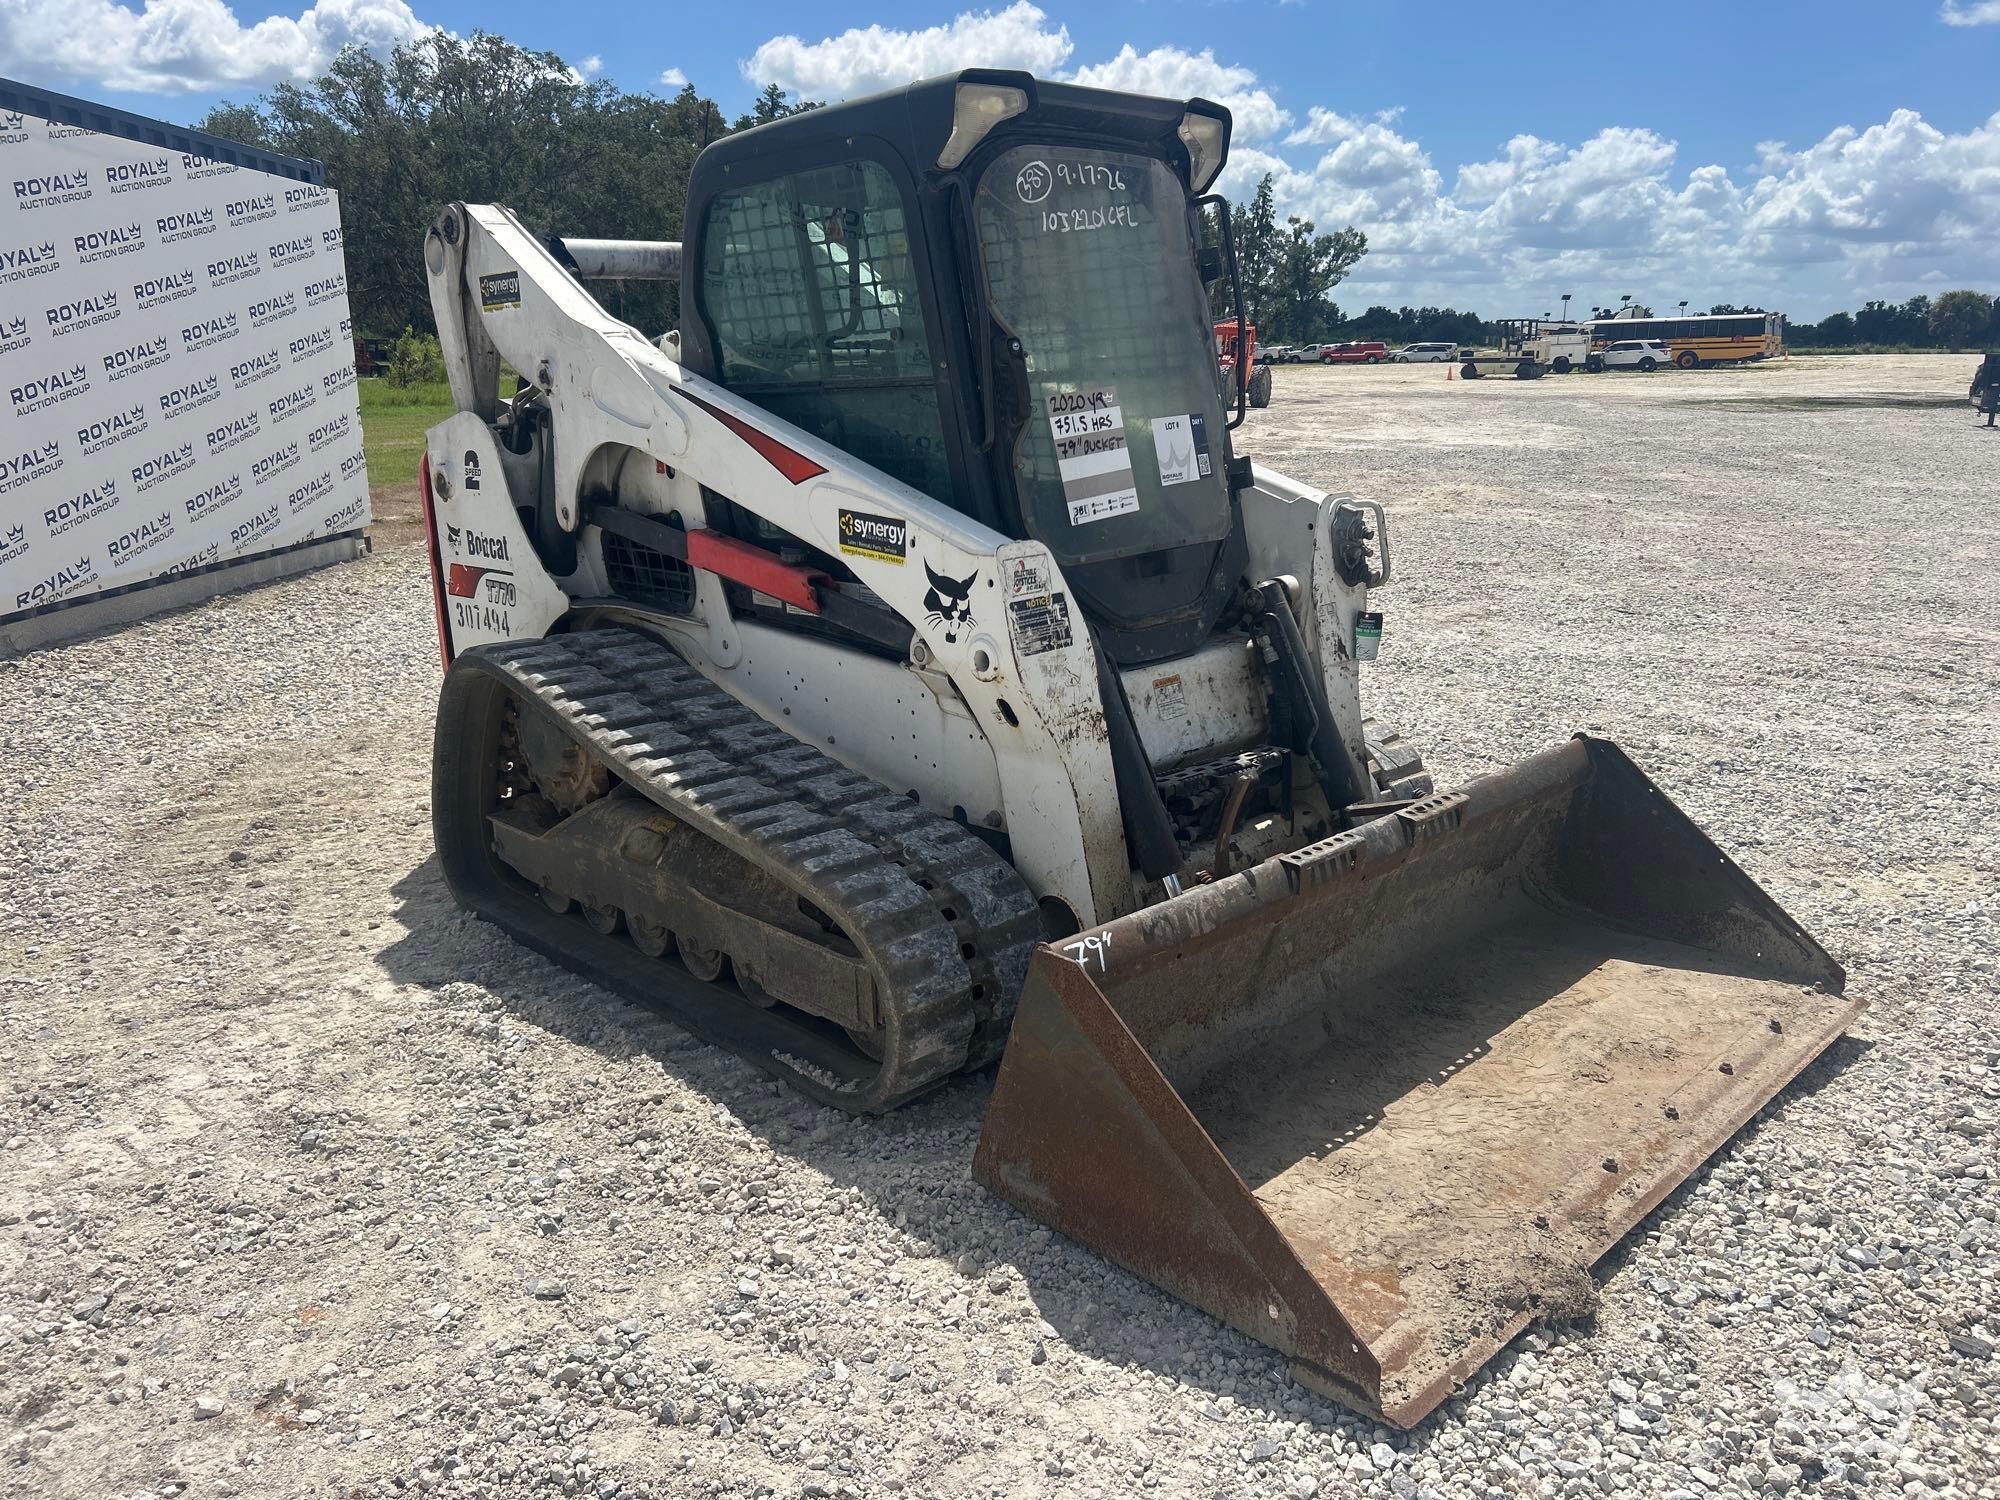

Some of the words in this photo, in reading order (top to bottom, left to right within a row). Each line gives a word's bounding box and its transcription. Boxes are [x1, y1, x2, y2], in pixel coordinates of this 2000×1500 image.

[0, 133, 28, 144] ROUP
[106, 161, 157, 182] ROYAL
[187, 169, 217, 180] AUCTION
[13, 174, 74, 198] ROYAL
[110, 182, 146, 194] AUCTION
[146, 176, 172, 188] GROUP
[285, 186, 320, 203] ROYAL
[20, 195, 62, 210] AUCTION
[62, 190, 92, 203] GROUP
[226, 198, 265, 218] ROYAL
[288, 202, 312, 213] AUCTION
[312, 198, 330, 208] GROUP
[156, 212, 203, 234] ROYAL
[230, 215, 256, 228] AUCTION
[257, 210, 277, 222] GROUP
[74, 228, 130, 252] ROYAL
[161, 226, 192, 244] AUCTION
[192, 224, 217, 237] GROUP
[322, 228, 342, 244] ROY
[79, 249, 117, 264] AUCTION
[118, 242, 146, 256] GROUP
[269, 239, 305, 259] ROYAL
[273, 256, 297, 269] AUCTION
[297, 250, 316, 262] GROUP
[27, 262, 60, 278] GROUP
[207, 255, 250, 278] ROYAL
[211, 274, 240, 288] AUCTION
[240, 267, 261, 280] GROUP
[134, 274, 183, 300] ROYAL
[138, 294, 172, 311] AUCTION
[172, 286, 197, 301] GROUP
[304, 278, 338, 298] ROYAL
[308, 295, 330, 308] AUCTION
[330, 287, 346, 300] GROUP
[490, 278, 518, 296] synergy
[46, 296, 105, 326] ROYAL
[249, 296, 286, 320] ROYAL
[252, 316, 278, 328] AUCTION
[278, 306, 298, 319] GROUP
[52, 318, 91, 338] AUCTION
[92, 310, 122, 326] GROUP
[182, 318, 227, 344] ROYAL
[186, 338, 217, 354] AUCTION
[217, 328, 240, 342] GROUP
[289, 331, 324, 355] ROYAL
[292, 350, 316, 364] AUCTION
[316, 340, 334, 354] GROUP
[103, 342, 156, 372] ROYAL
[108, 363, 144, 382] AUCTION
[144, 353, 171, 369] GROUP
[230, 354, 270, 380] ROYAL
[10, 371, 73, 405] ROYAL
[234, 374, 262, 390] AUCTION
[261, 364, 282, 378] GROUP
[322, 365, 353, 389] ROYAL
[16, 394, 59, 418] AUCTION
[60, 383, 91, 402] GROUP
[160, 381, 208, 410] ROYAL
[269, 390, 306, 416] ROYAL
[326, 384, 346, 398] AUCTION
[1050, 394, 1086, 412] 2020
[164, 402, 197, 420] AUCTION
[197, 390, 221, 406] GROUP
[272, 409, 298, 424] AUCTION
[297, 398, 316, 412] GROUP
[77, 412, 132, 446] ROYAL
[206, 418, 250, 446] ROYAL
[308, 420, 341, 446] ROYAL
[1092, 414, 1113, 432] HRS
[83, 435, 120, 457] AUCTION
[120, 422, 148, 440] GROUP
[210, 436, 240, 456] AUCTION
[240, 426, 261, 442] GROUP
[311, 436, 333, 453] AUCTION
[332, 427, 350, 442] GROUP
[0, 450, 46, 481] OYAL
[132, 450, 182, 483] ROYAL
[252, 448, 290, 477] ROYAL
[255, 467, 281, 486] AUCTION
[280, 456, 301, 472] GROUP
[464, 468, 482, 477] SPEED
[0, 474, 30, 494] CTION
[32, 459, 64, 480] GROUP
[136, 470, 170, 494] AUCTION
[170, 458, 196, 476] GROUP
[186, 482, 230, 514] ROYAL
[288, 476, 324, 506] ROYAL
[292, 496, 316, 516] AUCTION
[315, 484, 334, 502] GROUP
[44, 488, 104, 527] ROYAL
[50, 512, 90, 538] AUCTION
[90, 496, 120, 518] GROUP
[190, 502, 221, 524] AUCTION
[220, 488, 243, 507] GROUP
[325, 502, 356, 530] ROYAL
[349, 509, 365, 524] GROUP
[108, 520, 160, 558] ROYAL
[230, 512, 270, 544] ROYAL
[235, 530, 262, 550] AUCTION
[261, 518, 282, 536] GROUP
[854, 518, 906, 546] synergy
[113, 542, 148, 568] AUCTION
[148, 527, 175, 548] GROUP
[466, 530, 510, 561] Bobcat
[16, 567, 80, 608] ROYAL
[65, 572, 98, 594] GROUP
[486, 578, 516, 607] T770
[1026, 596, 1050, 609] NOTICE
[1063, 930, 1112, 972] 79"
